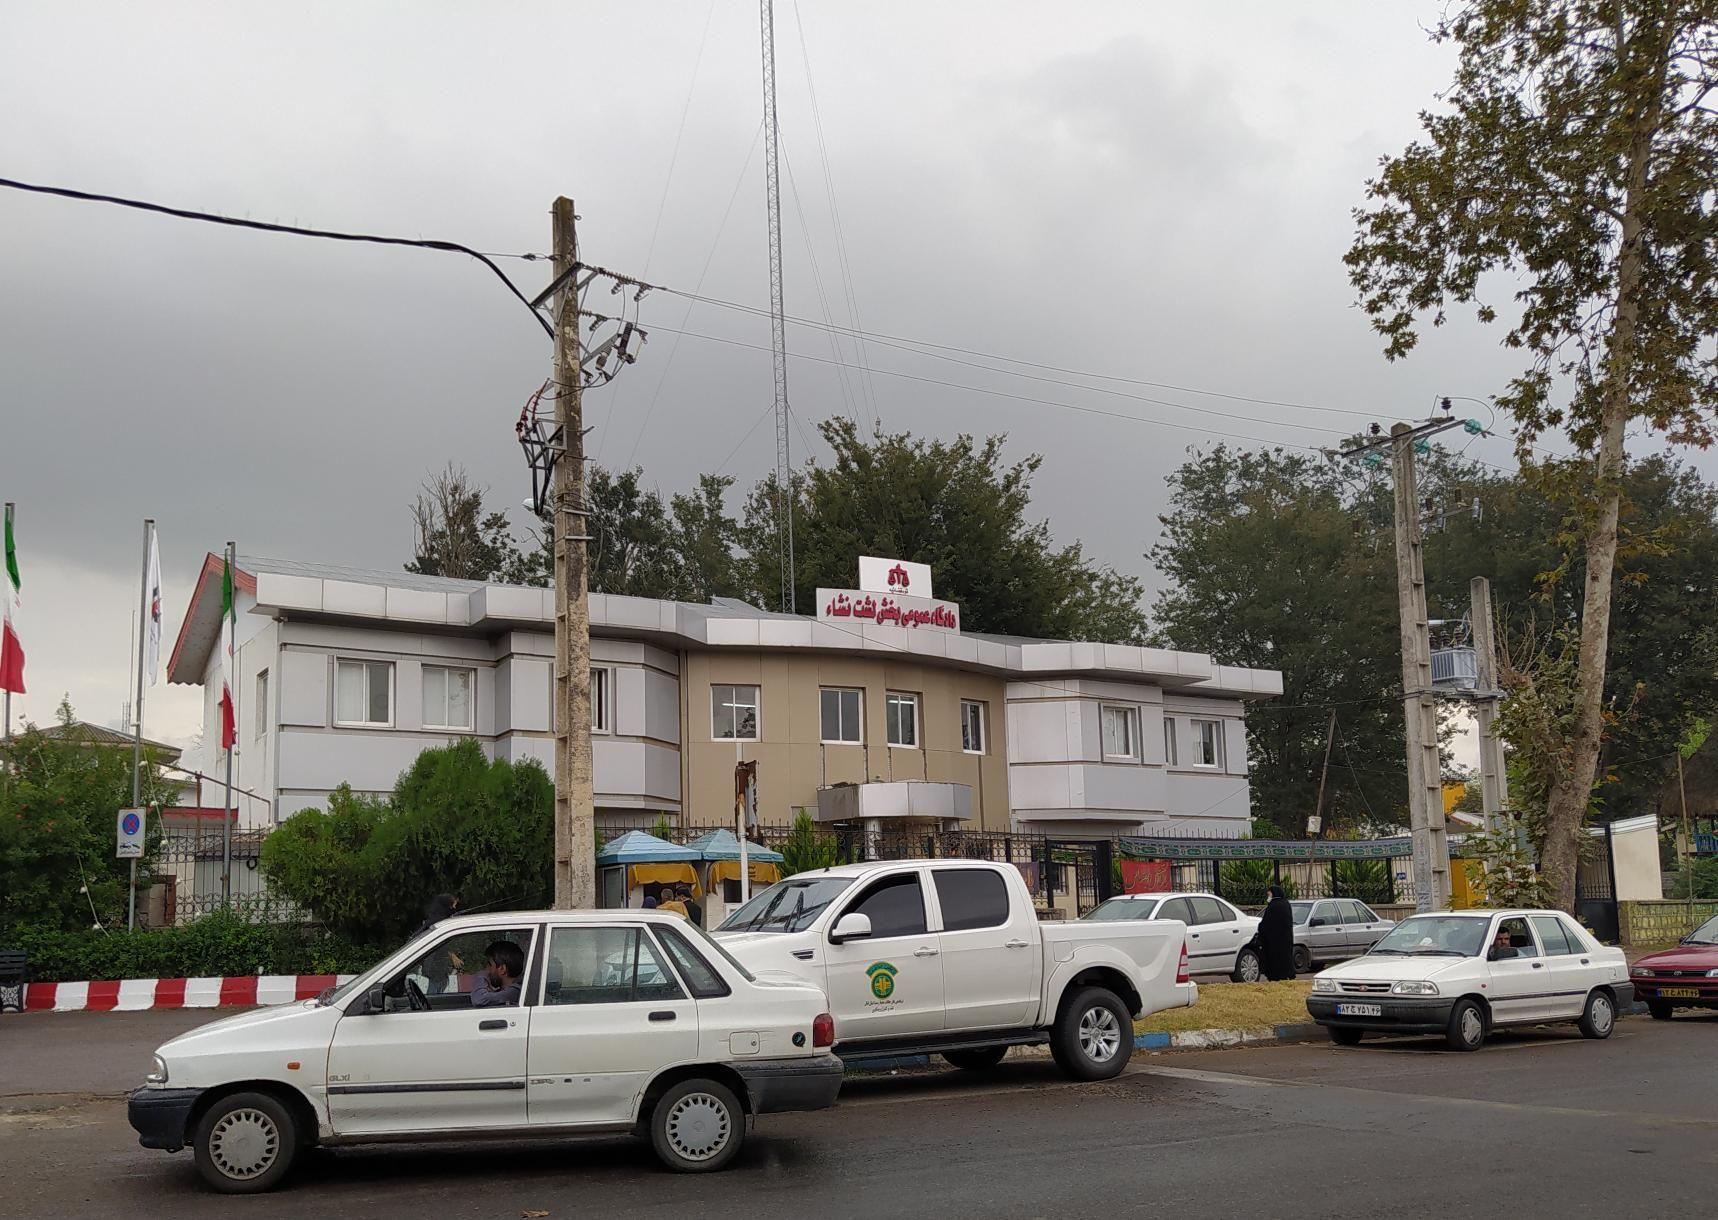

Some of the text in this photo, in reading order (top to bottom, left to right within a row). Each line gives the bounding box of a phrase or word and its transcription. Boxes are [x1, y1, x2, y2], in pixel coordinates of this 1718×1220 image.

[826, 593, 957, 629] دادگاه عمومی بخش لشت نشاء
